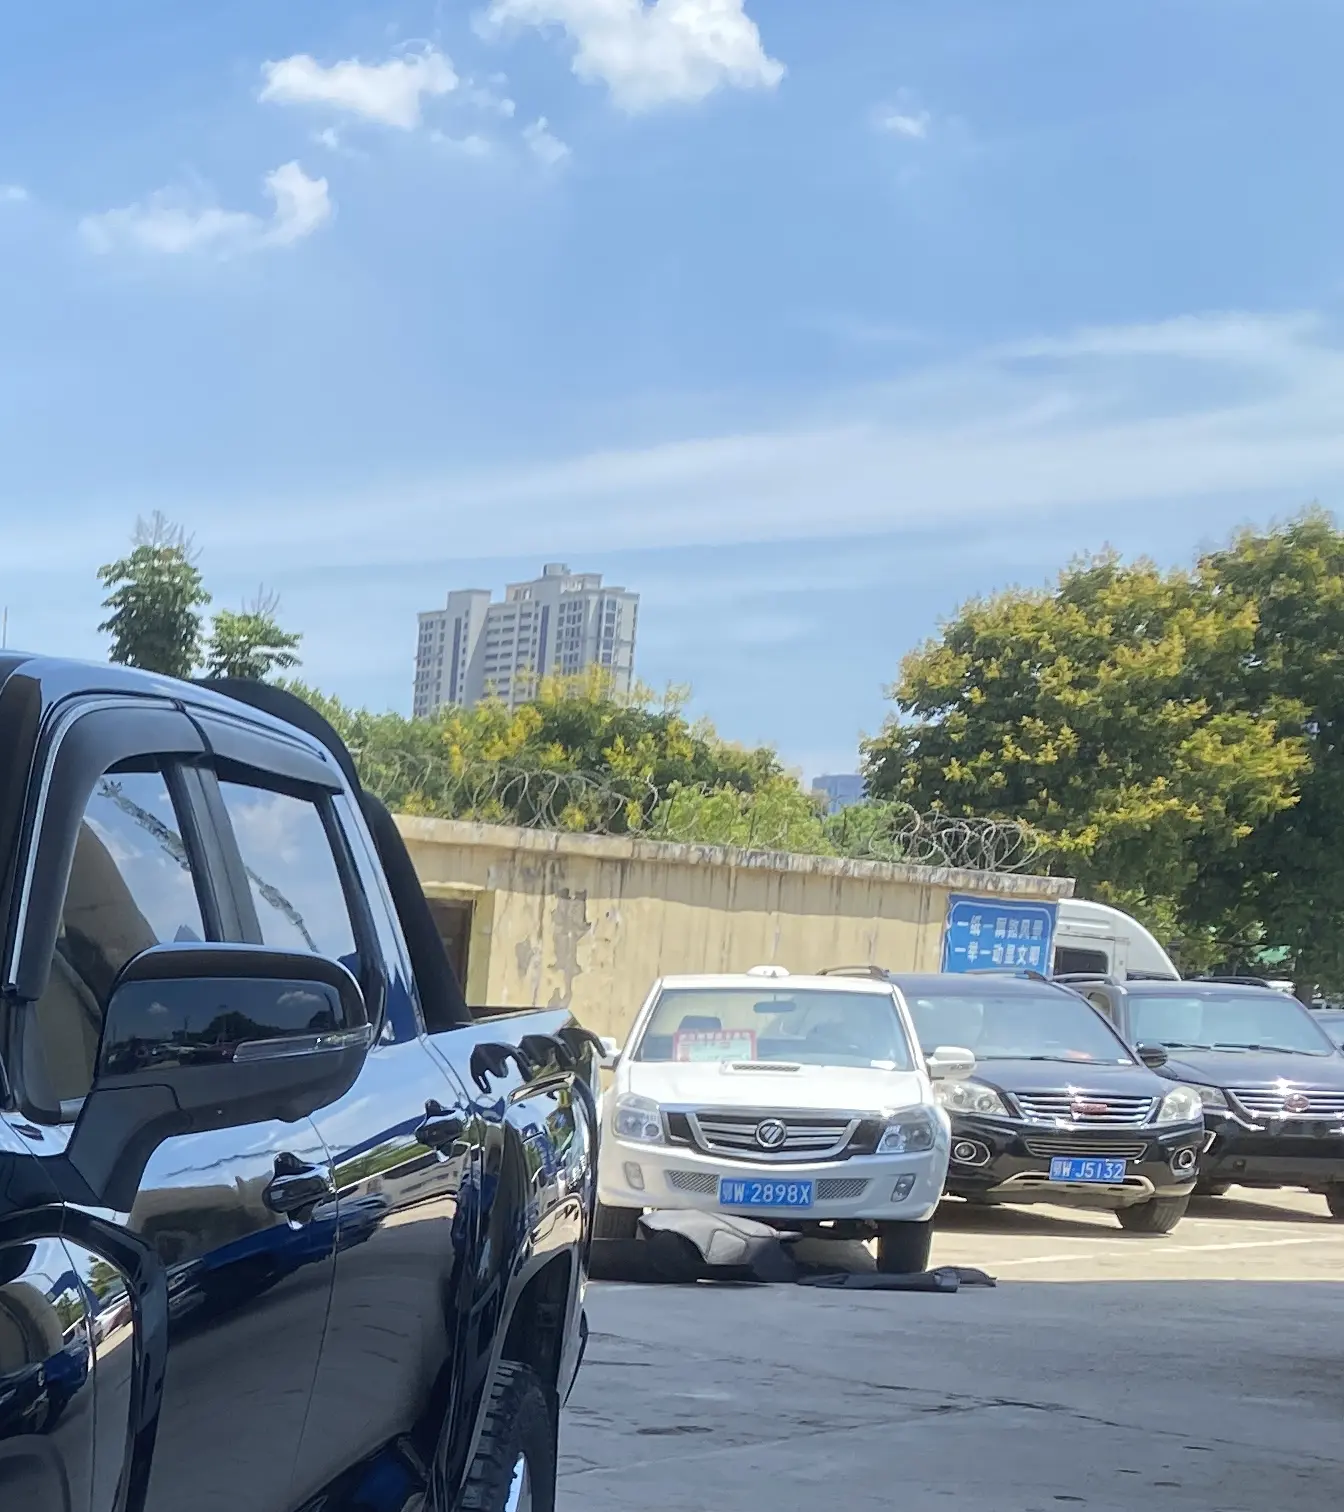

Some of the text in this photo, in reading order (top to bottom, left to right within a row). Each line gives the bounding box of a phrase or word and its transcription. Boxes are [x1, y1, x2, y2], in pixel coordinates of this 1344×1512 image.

[954, 941, 1041, 966] 一举一动显文明
